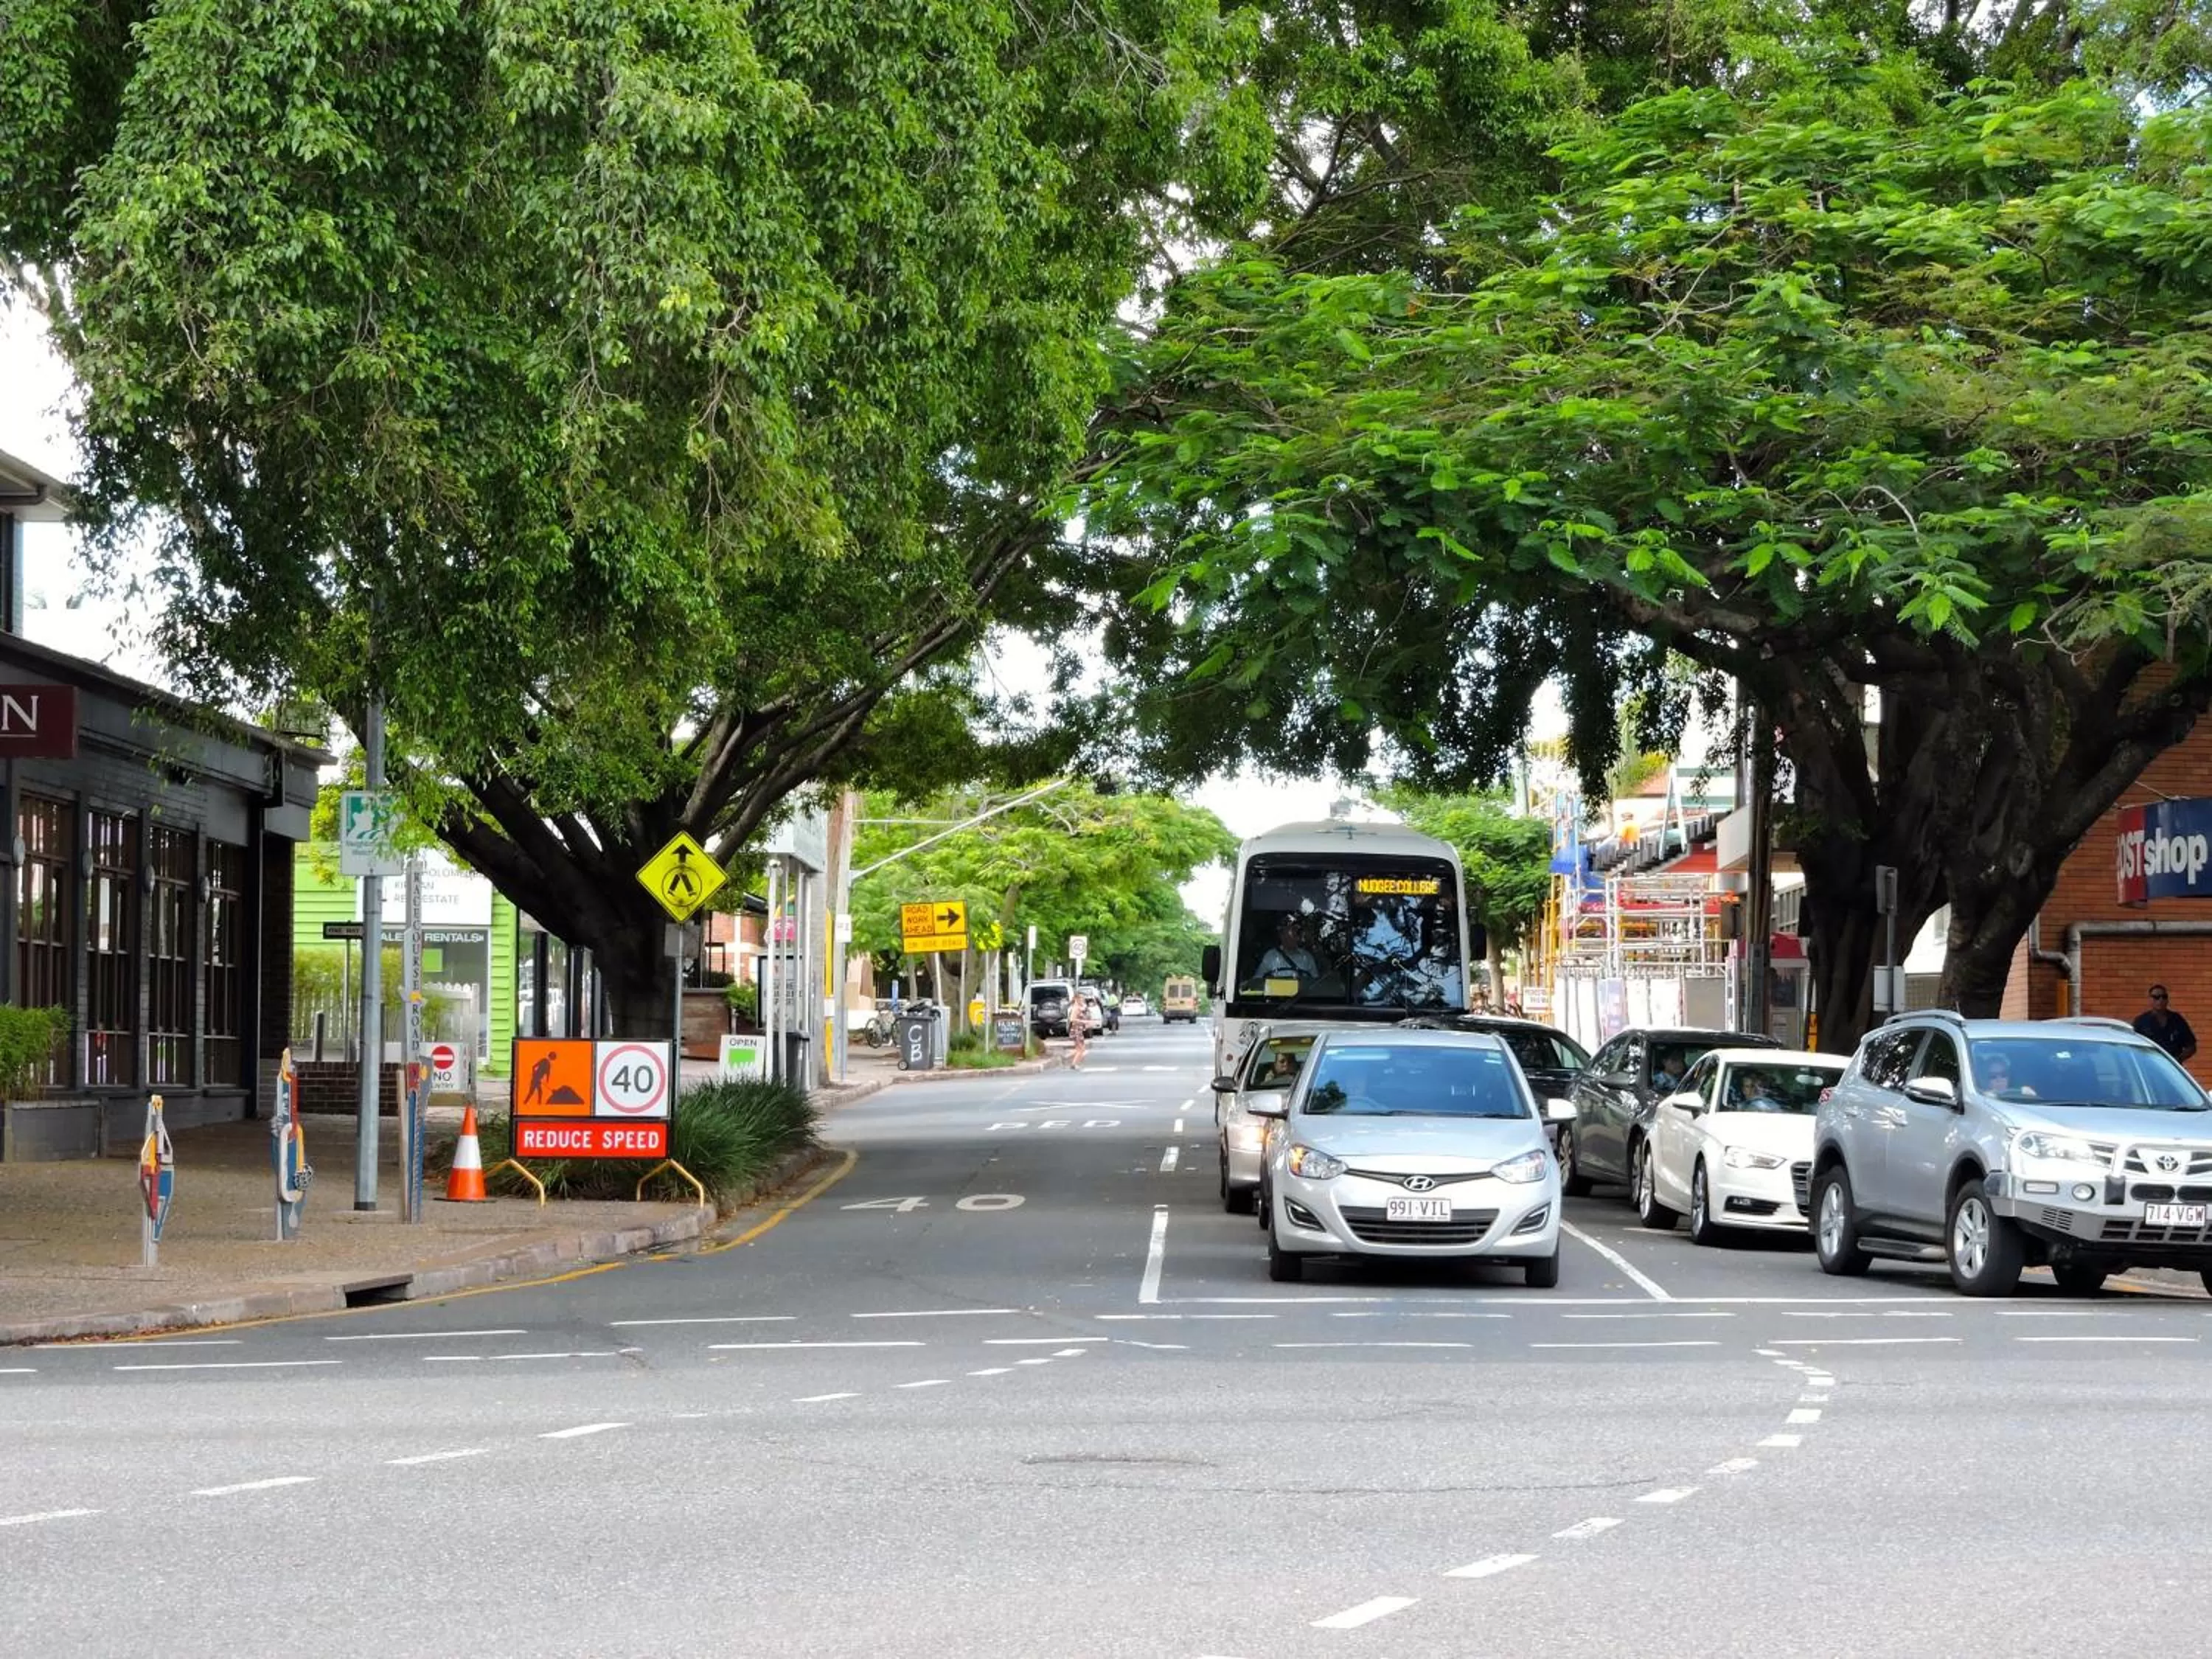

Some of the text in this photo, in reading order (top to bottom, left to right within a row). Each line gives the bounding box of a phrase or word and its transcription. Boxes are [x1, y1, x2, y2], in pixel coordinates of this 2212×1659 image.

[424, 933, 480, 942] RENTALS
[411, 1004, 420, 1051] ROAD
[729, 1038, 757, 1046] OPEN
[434, 1071, 452, 1082] NO
[611, 1065, 654, 1093] 40
[984, 1120, 1121, 1130] PED
[524, 1130, 660, 1148] REDUCE SPEED
